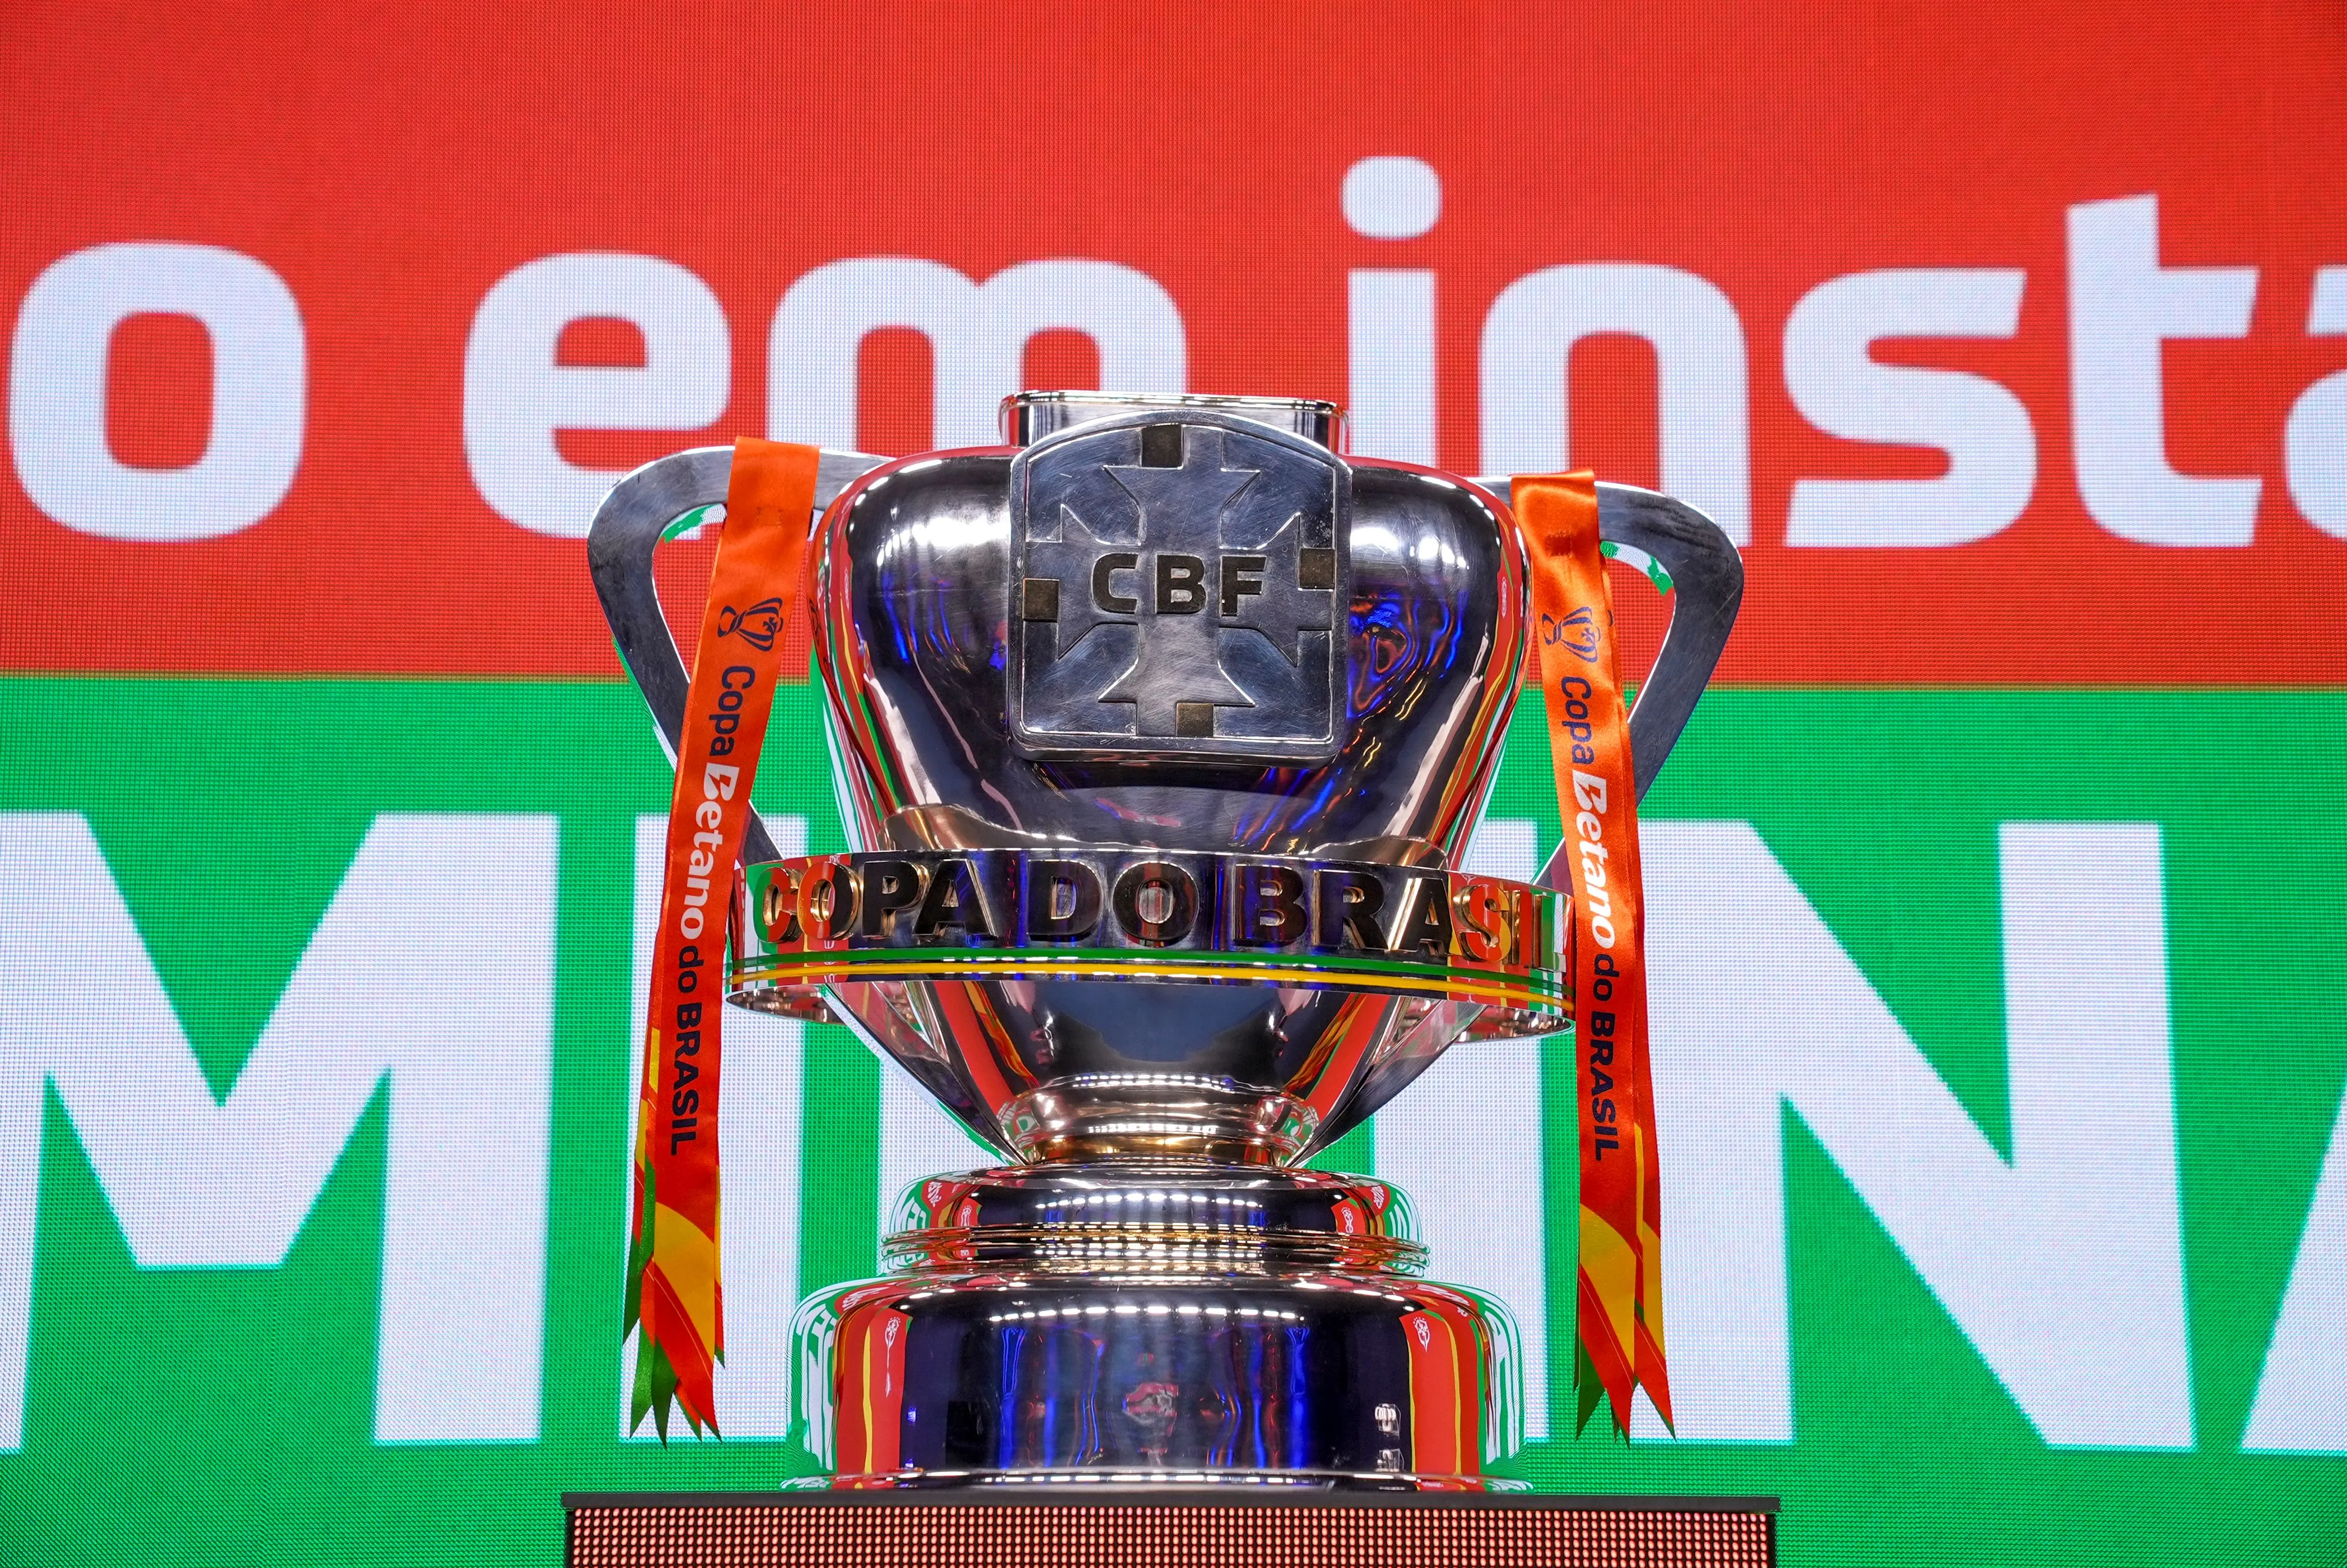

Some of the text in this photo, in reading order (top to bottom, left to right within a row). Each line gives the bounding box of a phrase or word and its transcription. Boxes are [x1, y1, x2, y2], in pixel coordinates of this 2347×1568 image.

[464, 252, 1187, 538] em
[1341, 155, 2347, 550] inst
[1091, 552, 1267, 617] CBF
[671, 665, 756, 1156] Copa Betano do BRASIL
[753, 859, 1567, 974] COPA DO BRASIL
[1560, 676, 1620, 1162] Copa Betano do BRASIL
